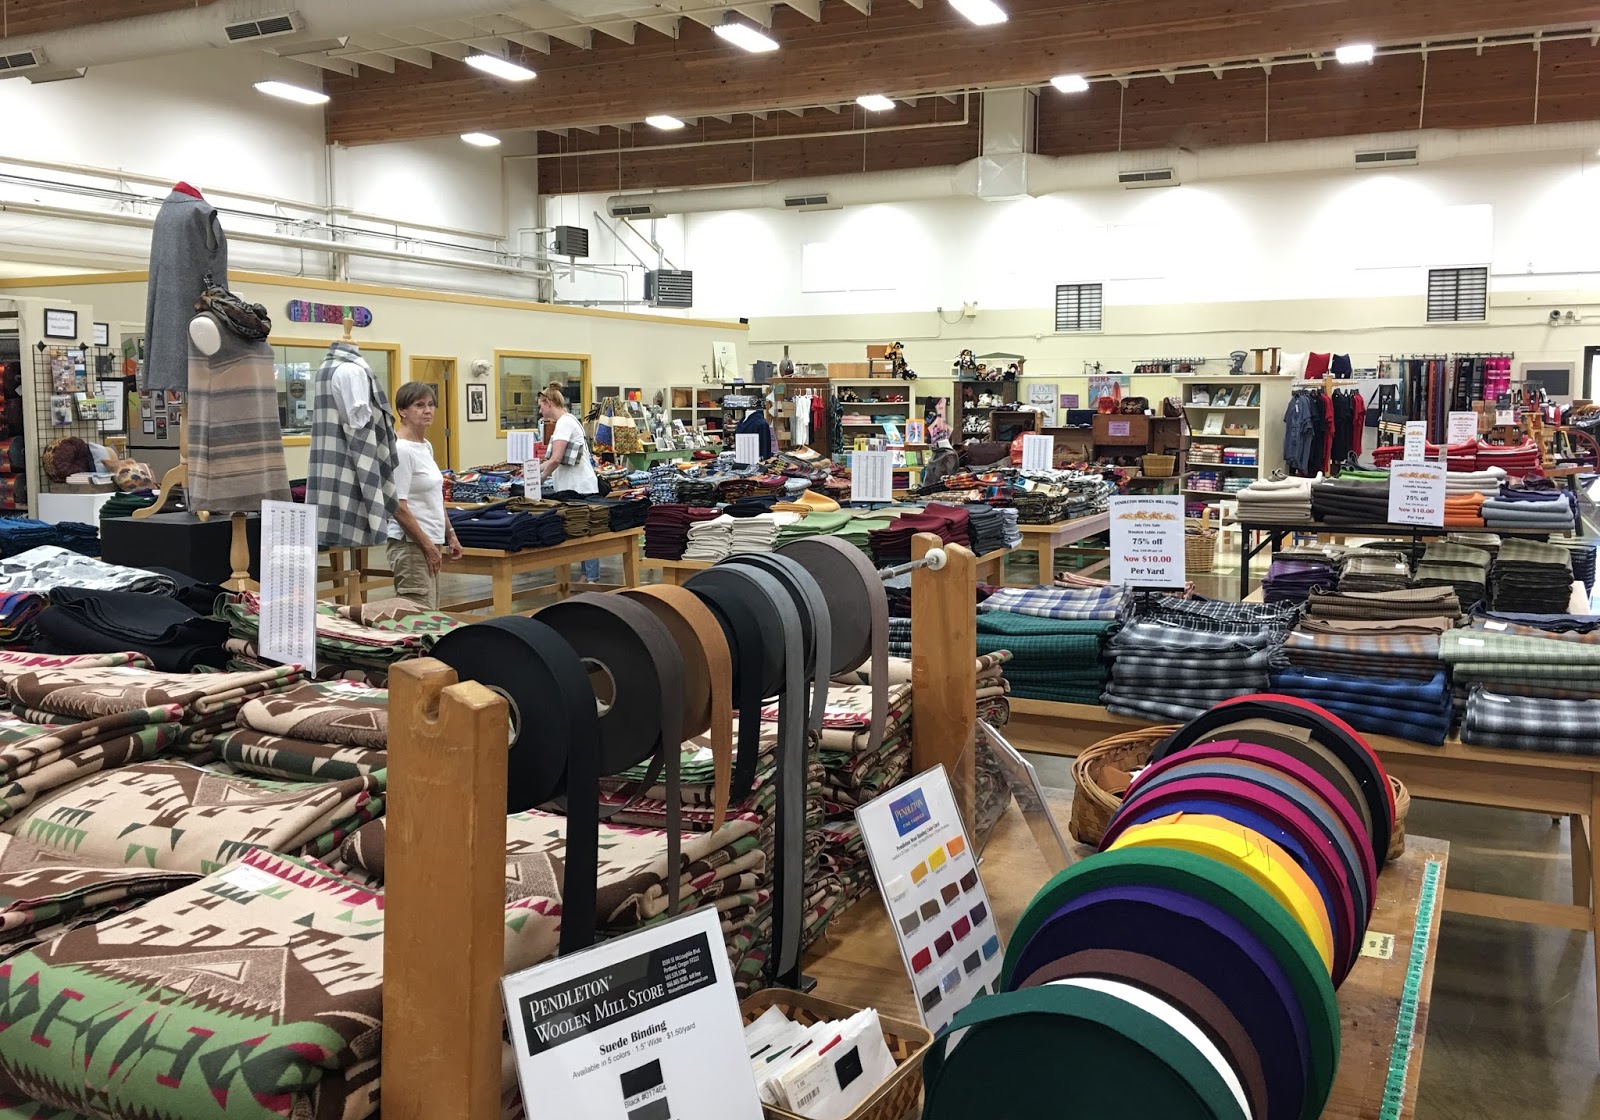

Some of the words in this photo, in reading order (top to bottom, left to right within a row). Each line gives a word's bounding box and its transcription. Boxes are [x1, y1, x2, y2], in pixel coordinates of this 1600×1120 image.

[894, 799, 923, 822] PENDLETON
[529, 976, 610, 1022] PENDLETON
[534, 1011, 591, 1043] WOOLEN
[594, 999, 628, 1023] MILL
[628, 984, 665, 1008] STORE
[573, 1063, 600, 1079] Available
[613, 1050, 631, 1062] colors
[647, 1036, 663, 1047] Wide
[666, 1022, 696, 1040] $1.50/yard
[599, 1037, 628, 1055] Suede
[631, 1020, 668, 1042] Binding
[624, 1098, 640, 1108] Black
